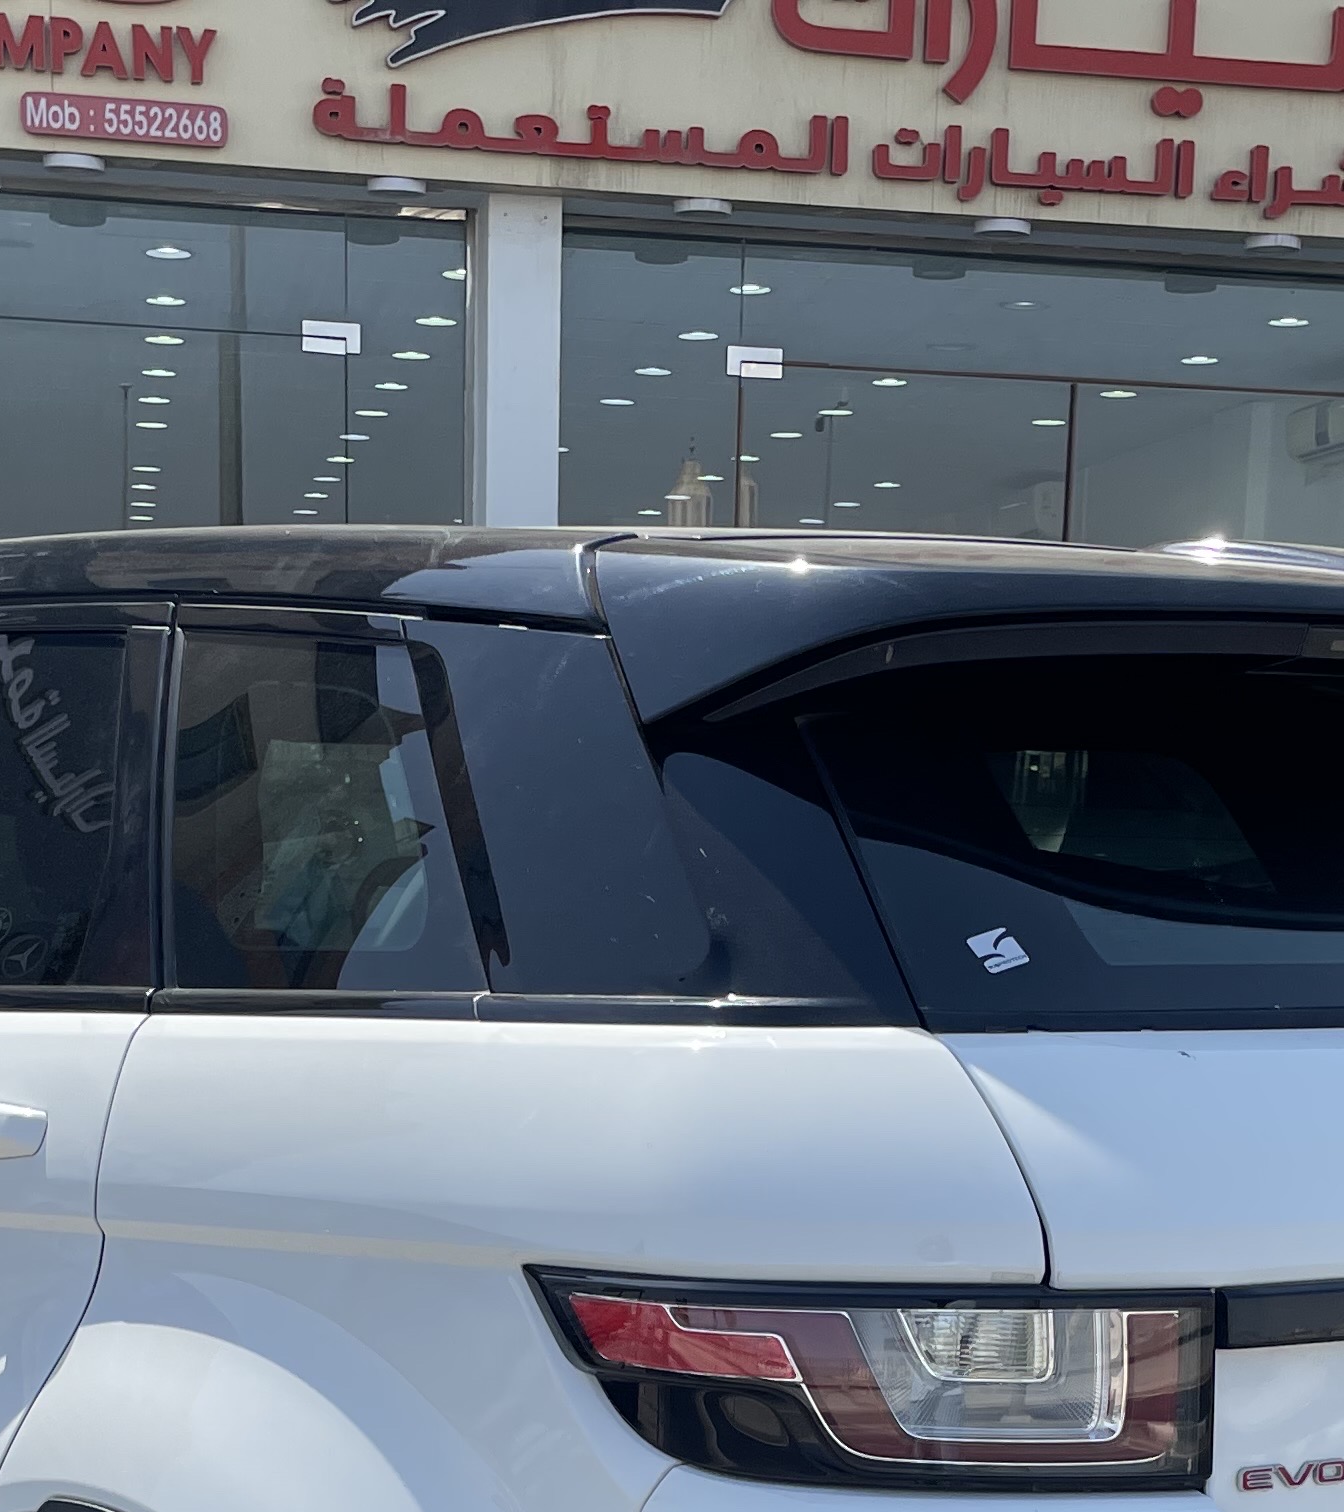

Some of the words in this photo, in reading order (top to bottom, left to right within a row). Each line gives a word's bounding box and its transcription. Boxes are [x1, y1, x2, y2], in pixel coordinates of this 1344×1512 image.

[103, 104, 224, 143] 55522668
[312, 76, 848, 178] المستعملة
[872, 124, 1198, 206] السيارات
